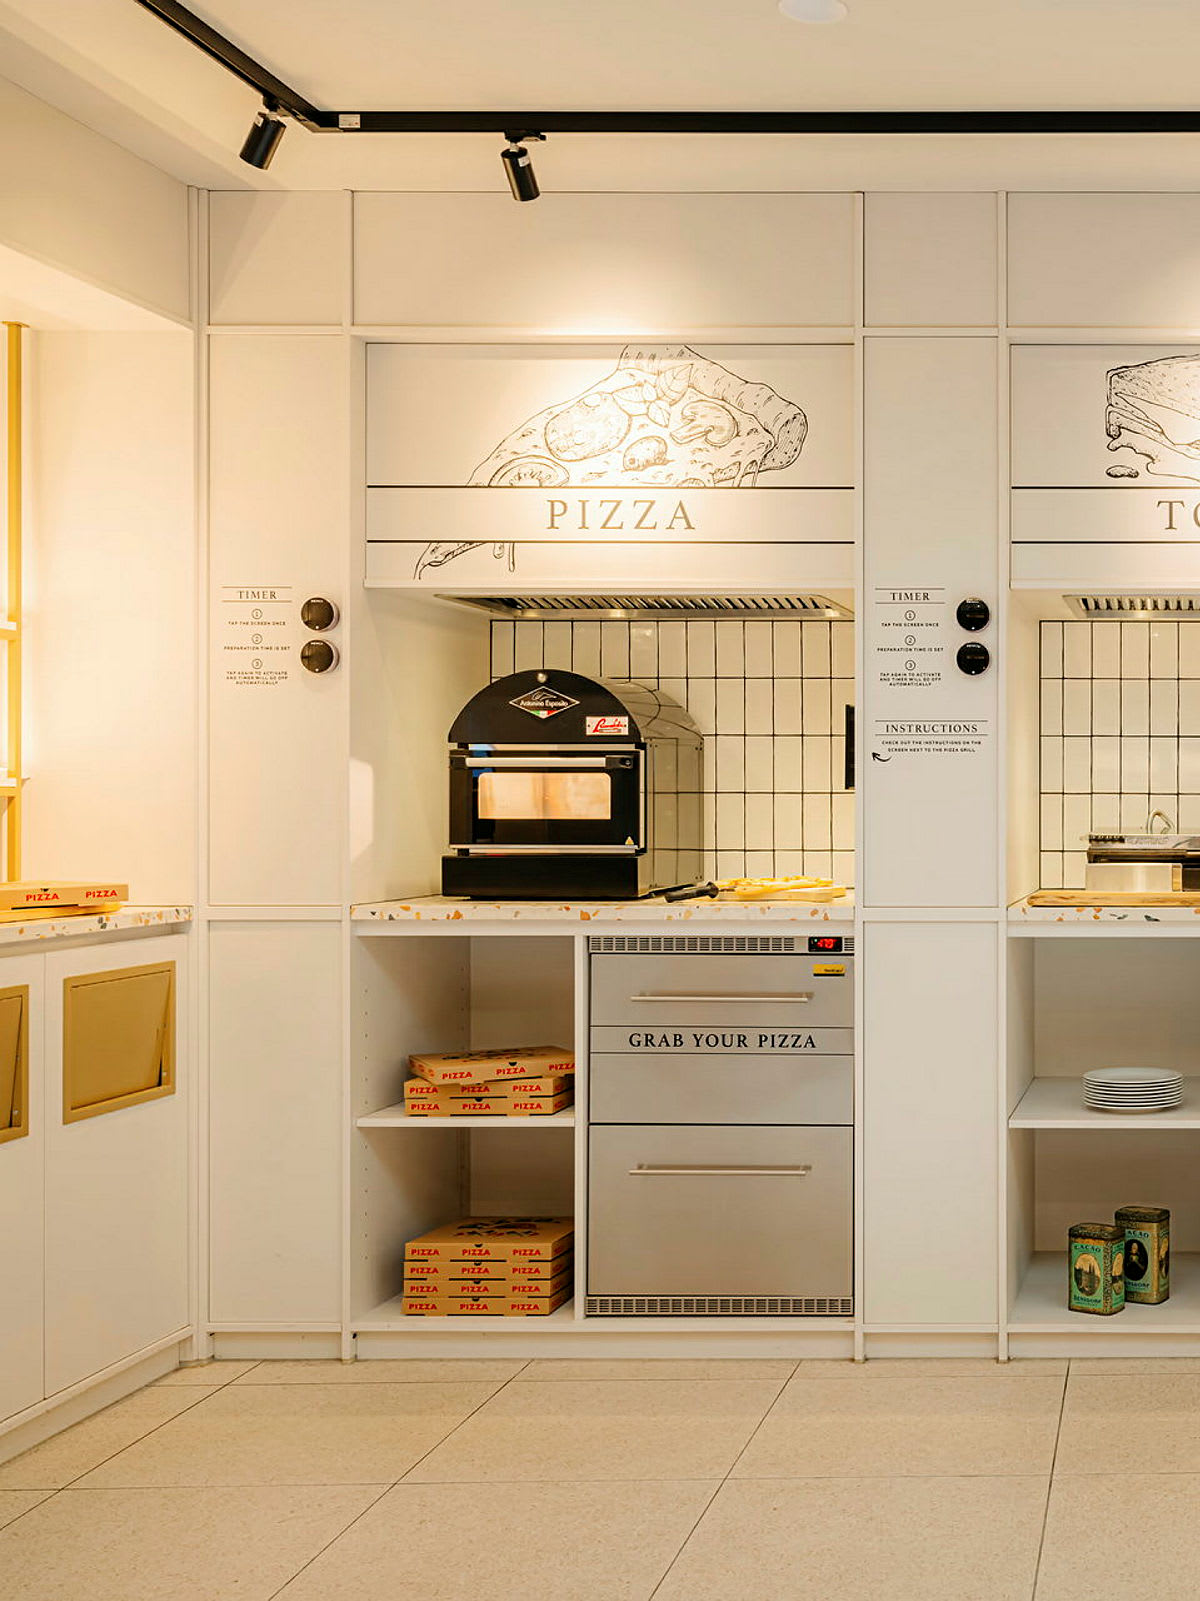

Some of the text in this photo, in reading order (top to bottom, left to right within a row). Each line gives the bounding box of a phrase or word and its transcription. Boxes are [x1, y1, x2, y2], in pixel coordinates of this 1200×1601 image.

[546, 499, 695, 530] PIZZA
[237, 590, 277, 599] TIMER
[890, 592, 930, 601] TIMER
[885, 724, 978, 733] INSTRUCTIONS
[26, 889, 117, 901] PIZZA PIZZA
[629, 1033, 816, 1049] GRAB YOUR PIZZA
[441, 1071, 473, 1079] PIZZA
[496, 1067, 526, 1076] PIZZA
[409, 1086, 438, 1094] PIZZA
[512, 1084, 542, 1092] PIZZA
[513, 1102, 542, 1110] PIZZA
[1126, 1230, 1149, 1238] ACAO
[512, 1285, 541, 1293] PIZZA
